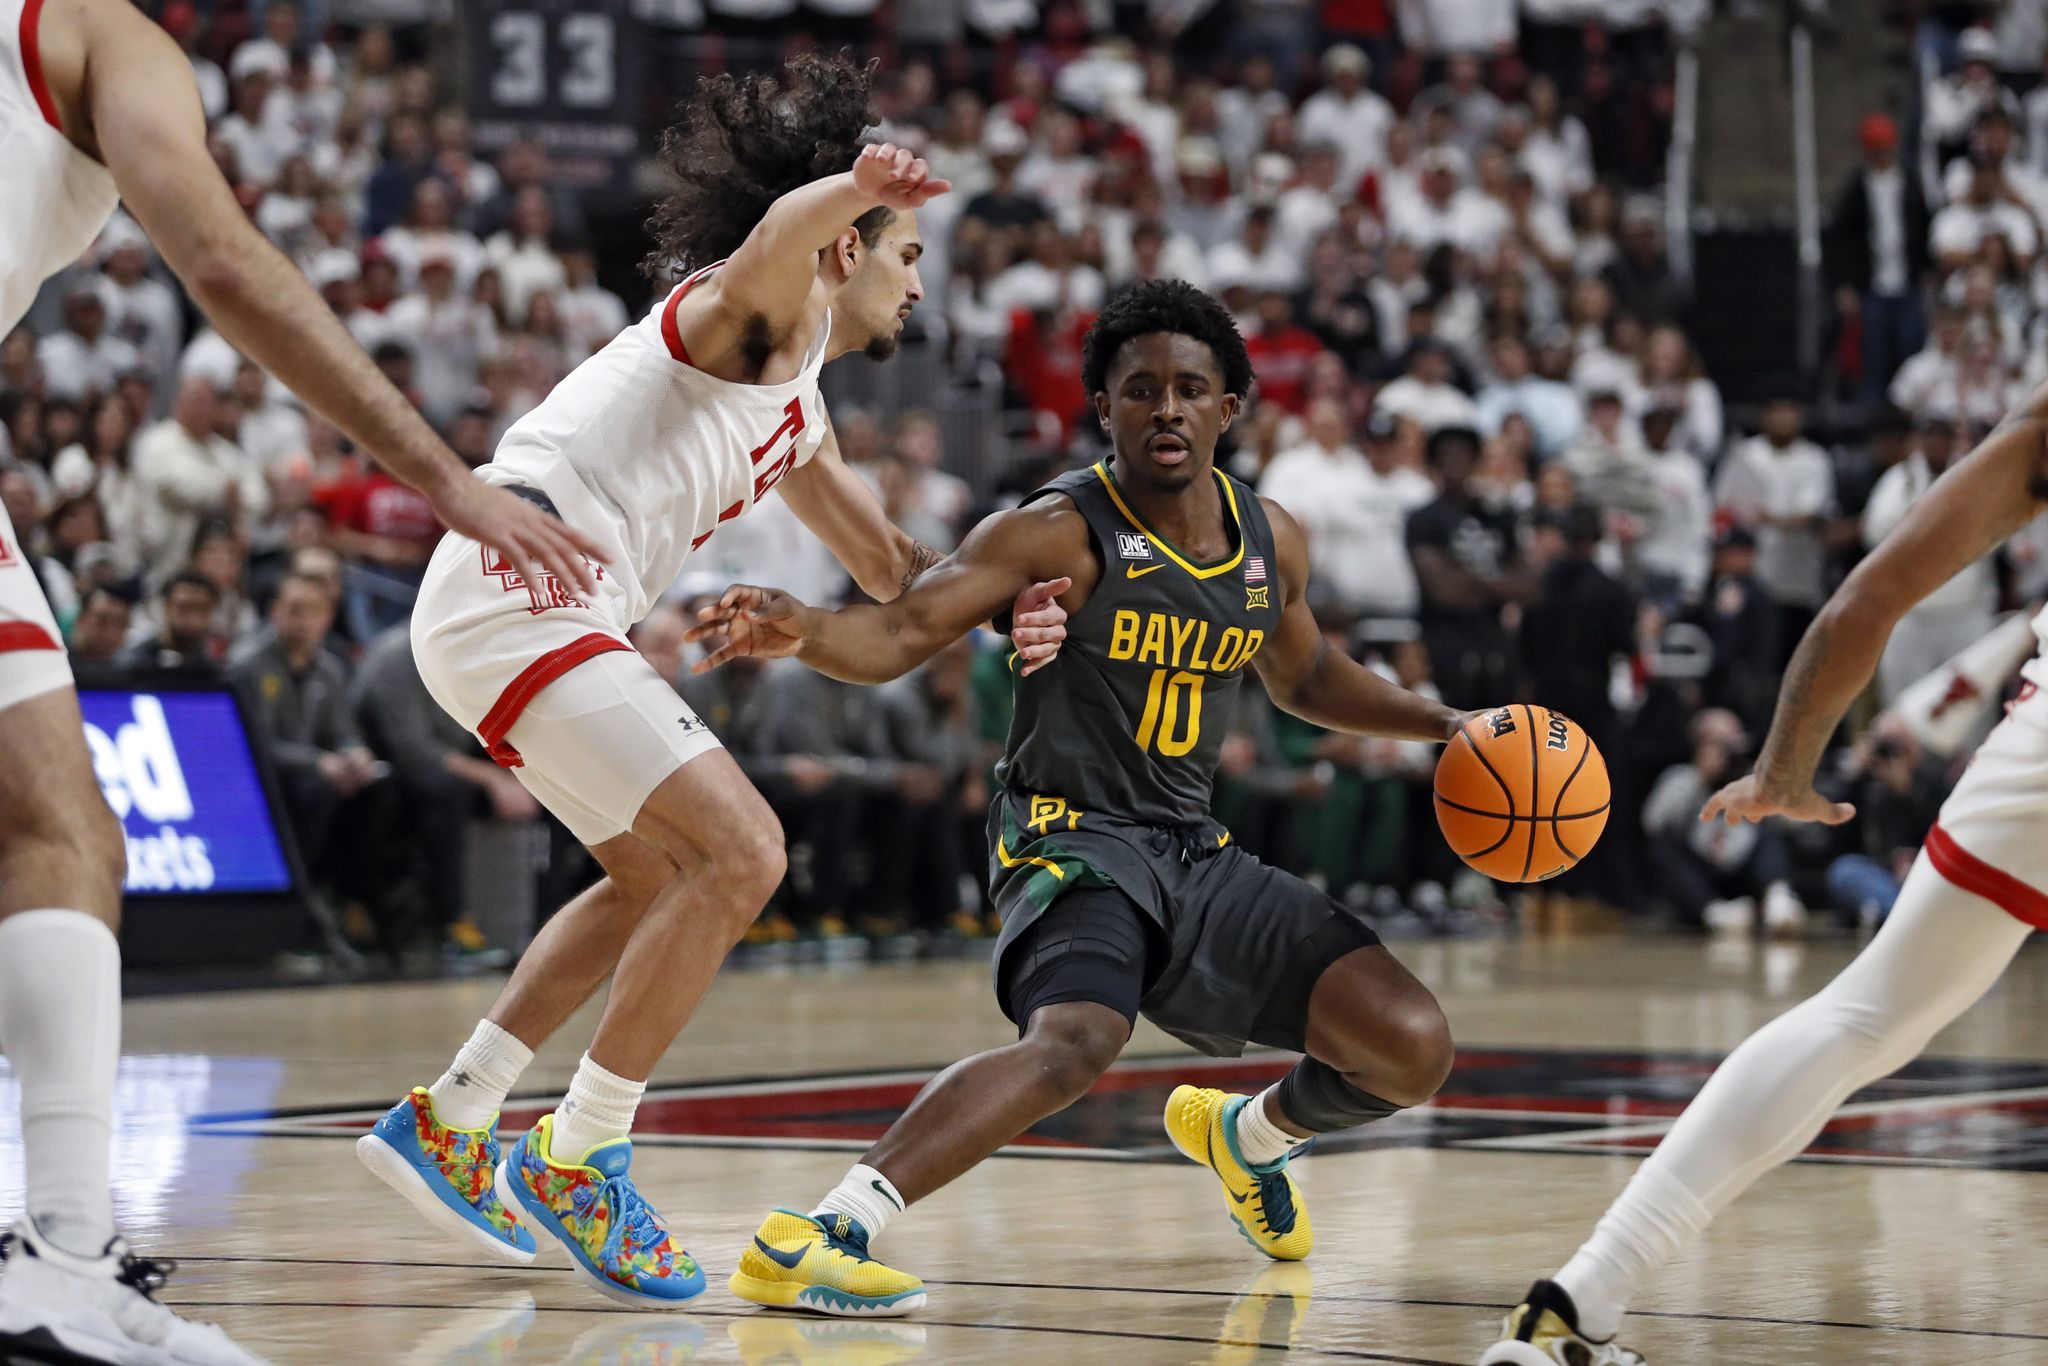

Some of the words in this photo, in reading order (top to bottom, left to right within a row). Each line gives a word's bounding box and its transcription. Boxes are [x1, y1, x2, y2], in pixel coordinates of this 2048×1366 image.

[1119, 535, 1149, 552] ONE
[1109, 609, 1264, 673] BAYLOR
[1135, 669, 1205, 758] 10
